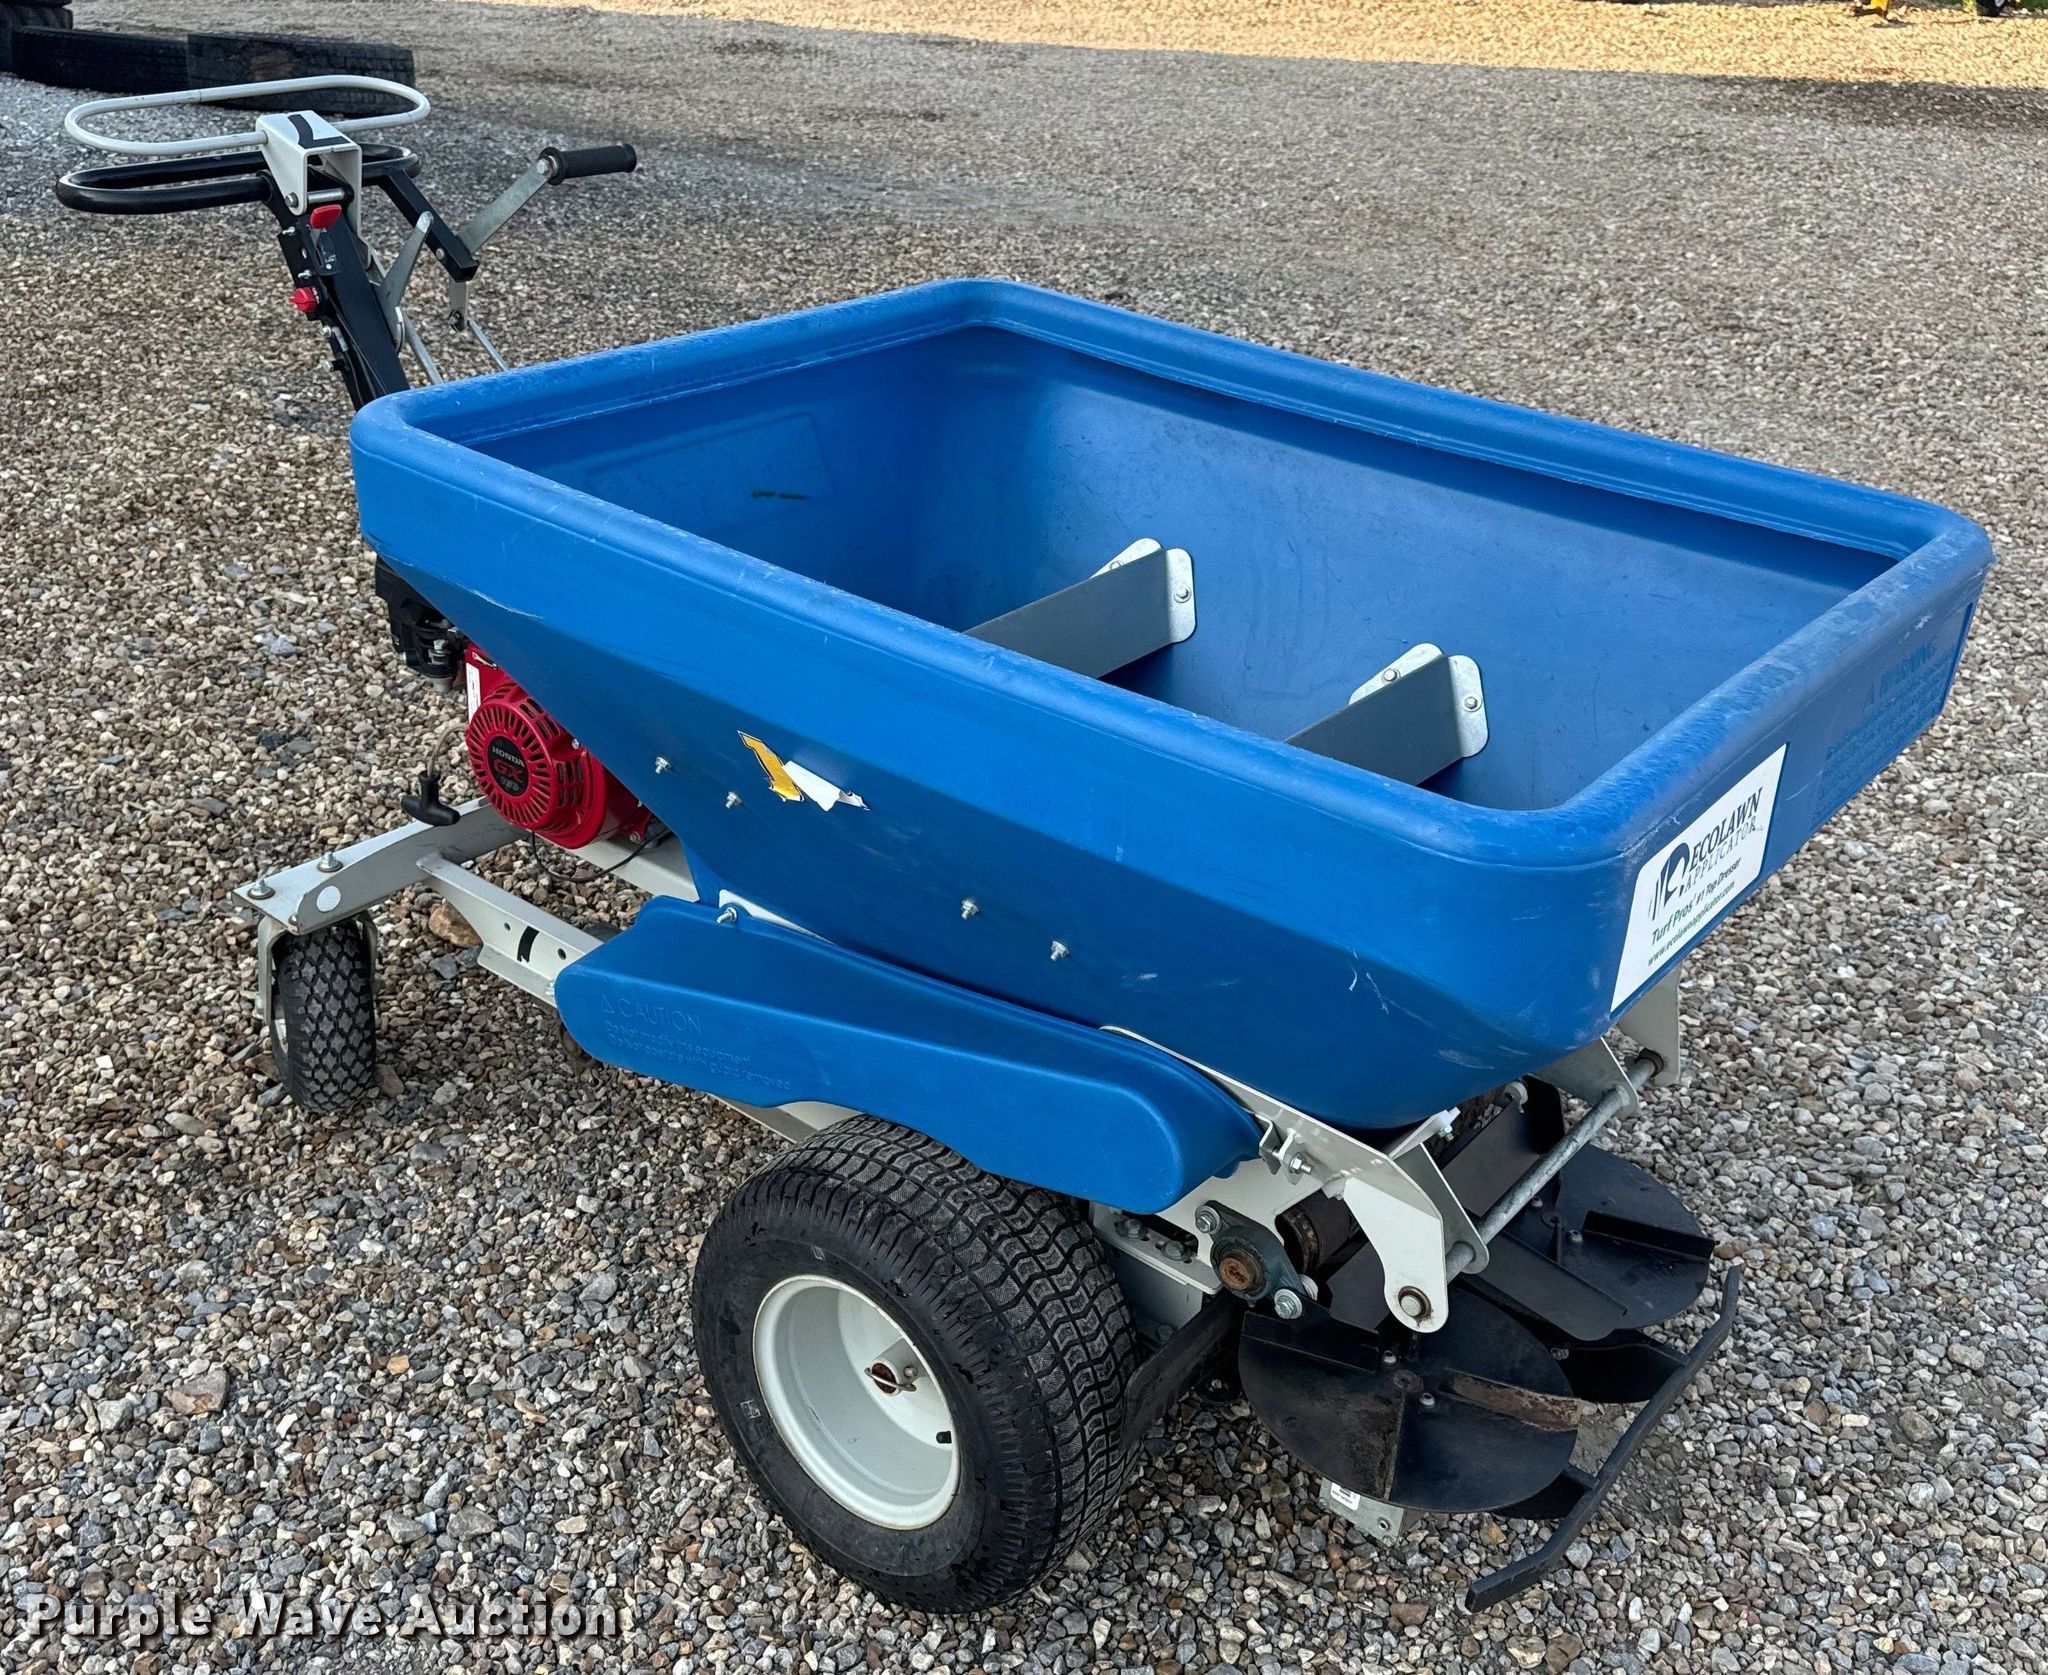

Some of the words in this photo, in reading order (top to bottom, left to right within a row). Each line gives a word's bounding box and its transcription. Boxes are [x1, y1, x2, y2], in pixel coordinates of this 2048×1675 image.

[492, 746, 525, 768] HONDA
[494, 759, 522, 782] GX
[1684, 815, 1756, 894] APPLICATOR
[1689, 787, 1763, 873] ECOLAWN
[1652, 914, 1674, 946] Turf
[1706, 879, 1718, 896] Top
[1717, 857, 1741, 886] Dresser
[618, 997, 703, 1035] CAUTION
